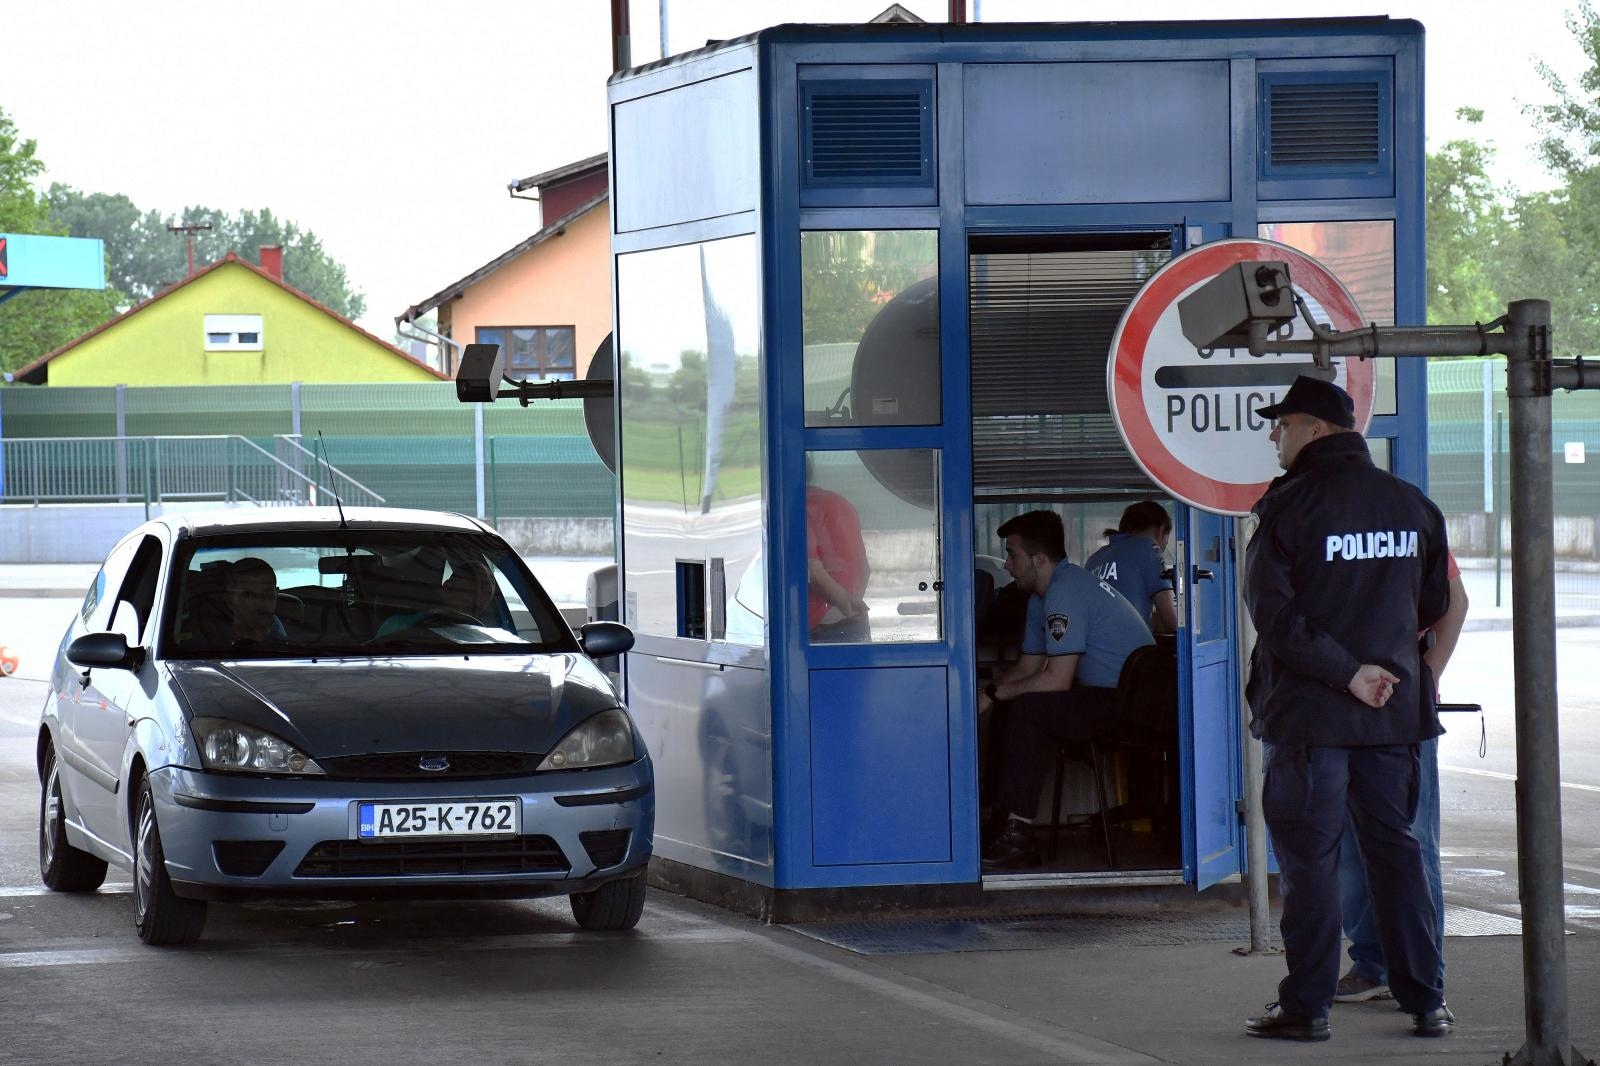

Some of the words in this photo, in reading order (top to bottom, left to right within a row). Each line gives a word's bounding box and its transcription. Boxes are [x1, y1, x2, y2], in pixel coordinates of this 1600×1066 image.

[1326, 531, 1418, 561] POLICIJA
[361, 824, 374, 832] BIH
[379, 805, 512, 833] A25-K-762
